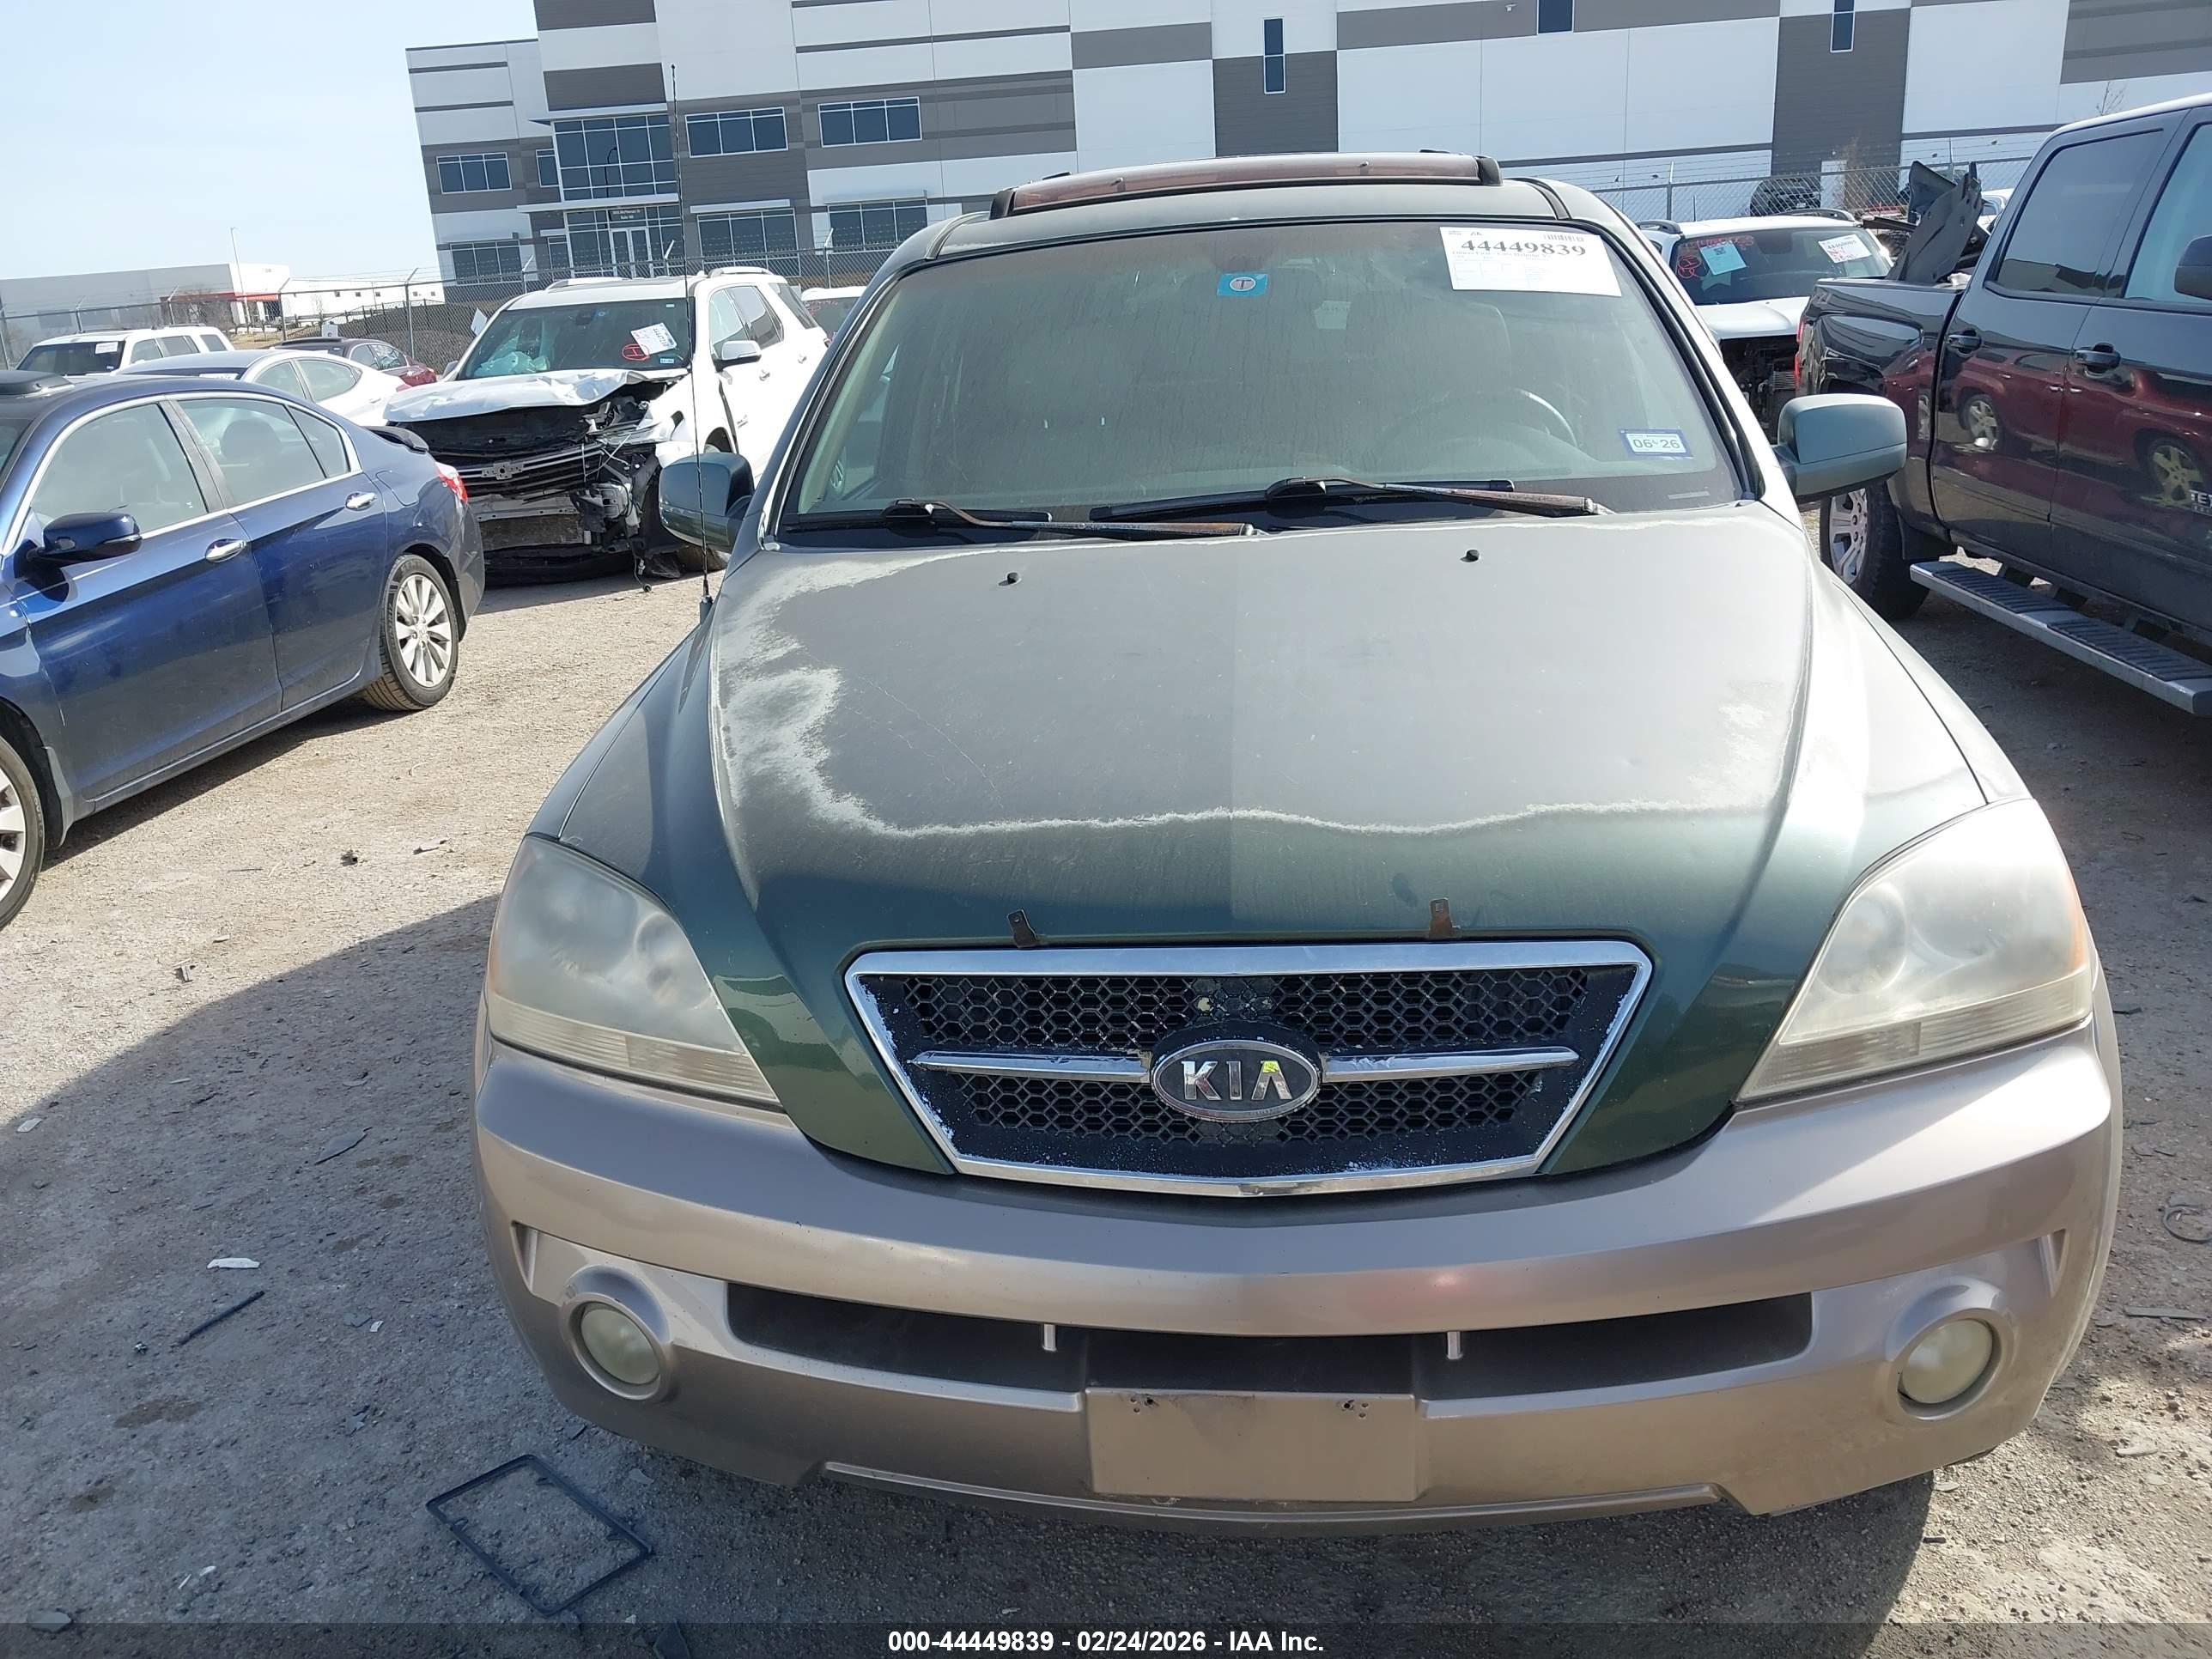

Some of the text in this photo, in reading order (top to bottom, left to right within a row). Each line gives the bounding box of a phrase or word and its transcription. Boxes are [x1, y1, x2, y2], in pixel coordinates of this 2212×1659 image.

[1461, 240, 1586, 256] 44449839
[1236, 279, 1252, 289] T
[1632, 439, 1680, 449] 06 26
[1181, 1060, 1292, 1101] KIA
